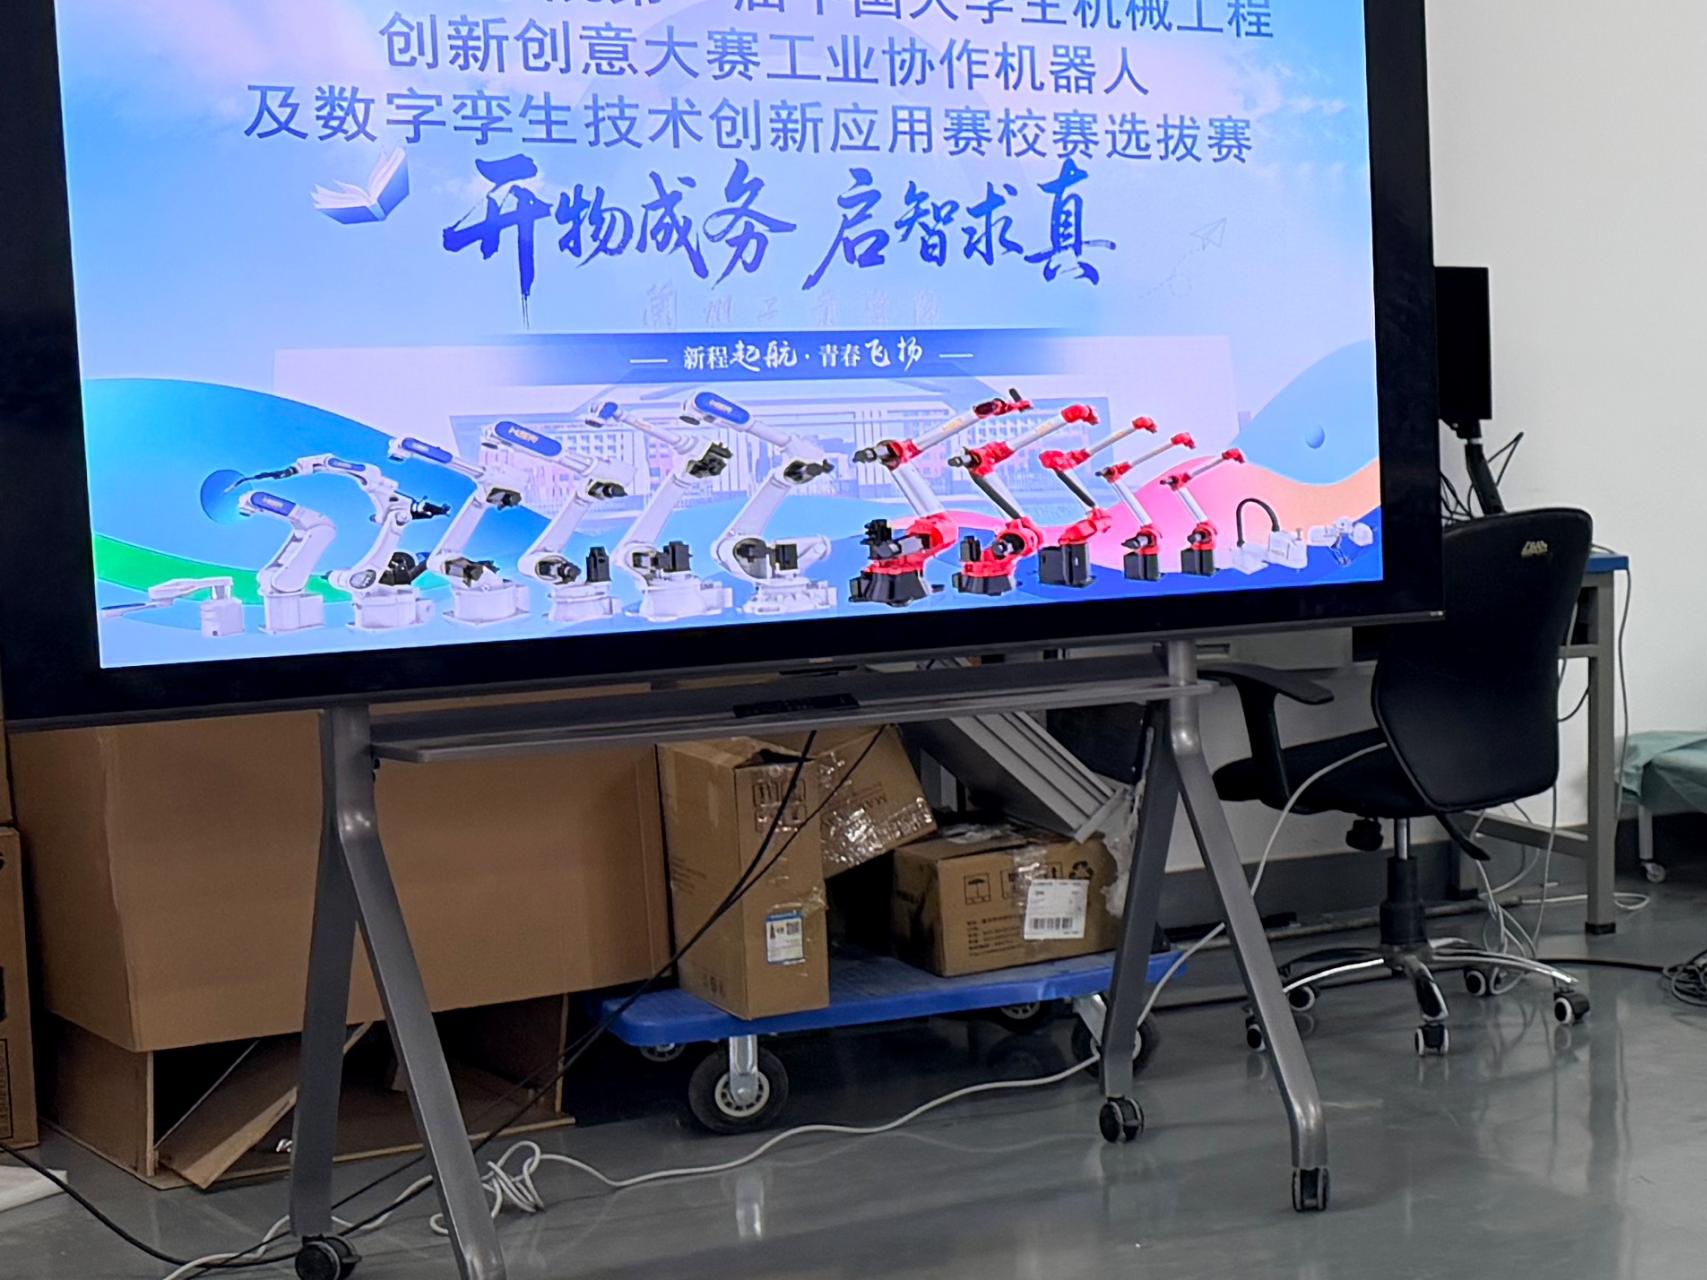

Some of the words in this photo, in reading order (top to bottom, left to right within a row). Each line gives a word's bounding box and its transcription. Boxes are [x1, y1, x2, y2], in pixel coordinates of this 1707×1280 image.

[378, 11, 1150, 96] 创新创意大赛工业协作机器人
[243, 83, 1255, 164] 及数字孪生技术创新应用赛校赛选拔赛
[443, 153, 797, 324] 开物成务
[802, 158, 1117, 291] 启智求真
